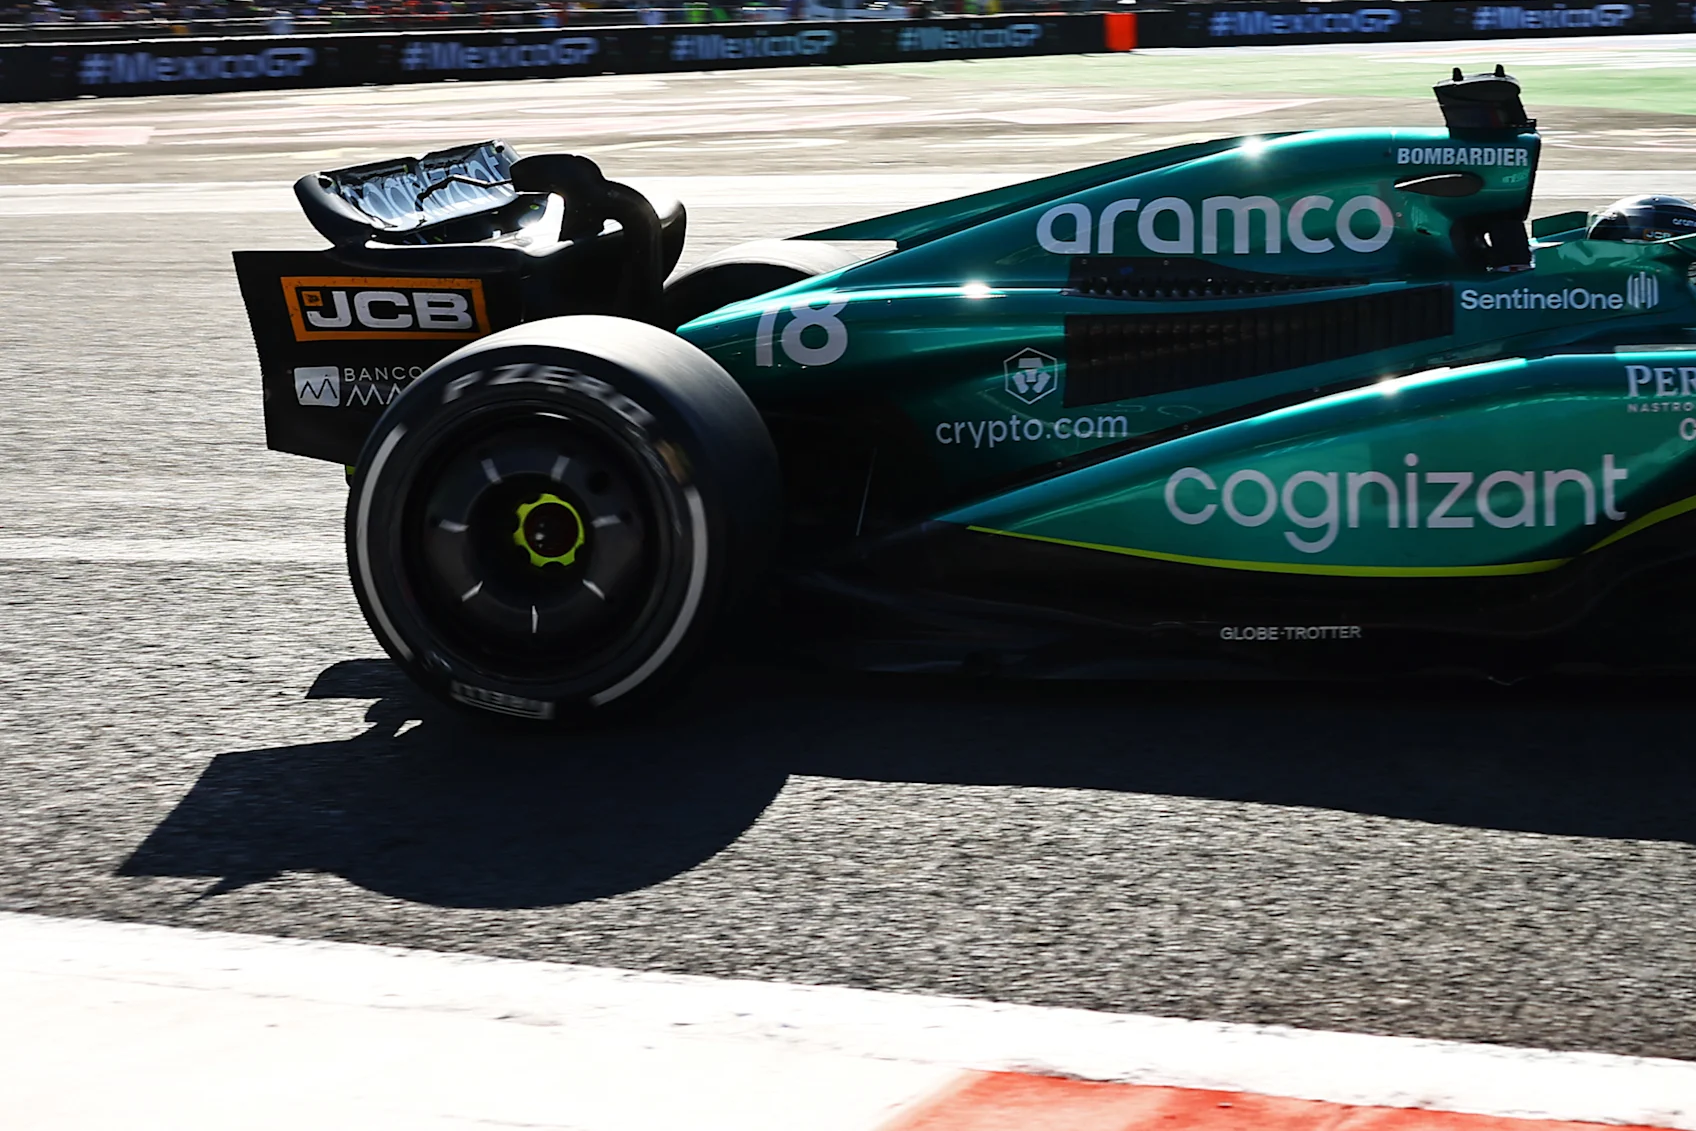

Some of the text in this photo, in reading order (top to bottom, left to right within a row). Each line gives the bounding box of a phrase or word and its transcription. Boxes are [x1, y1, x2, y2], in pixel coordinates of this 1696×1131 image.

[1210, 7, 1399, 37] #MexicoGP
[1473, 3, 1635, 30] #MexicoGP
[671, 30, 837, 61] #MexicoGP
[900, 23, 1042, 52] #MexicoGP
[78, 47, 317, 84] #MexicoGP
[400, 37, 600, 70] #MexicoGP
[1397, 147, 1528, 166] BOMBARDIER
[1036, 194, 1394, 254] aramco
[307, 290, 473, 330] JCB
[1460, 288, 1624, 310] SentinelOne
[755, 294, 848, 366] 18
[344, 367, 424, 382] BANCO
[1627, 402, 1695, 413] NASTRO
[936, 415, 1128, 448] crypto.com
[1164, 452, 1629, 553] cognizant
[1220, 625, 1362, 641] GLOBE-TROTTER
